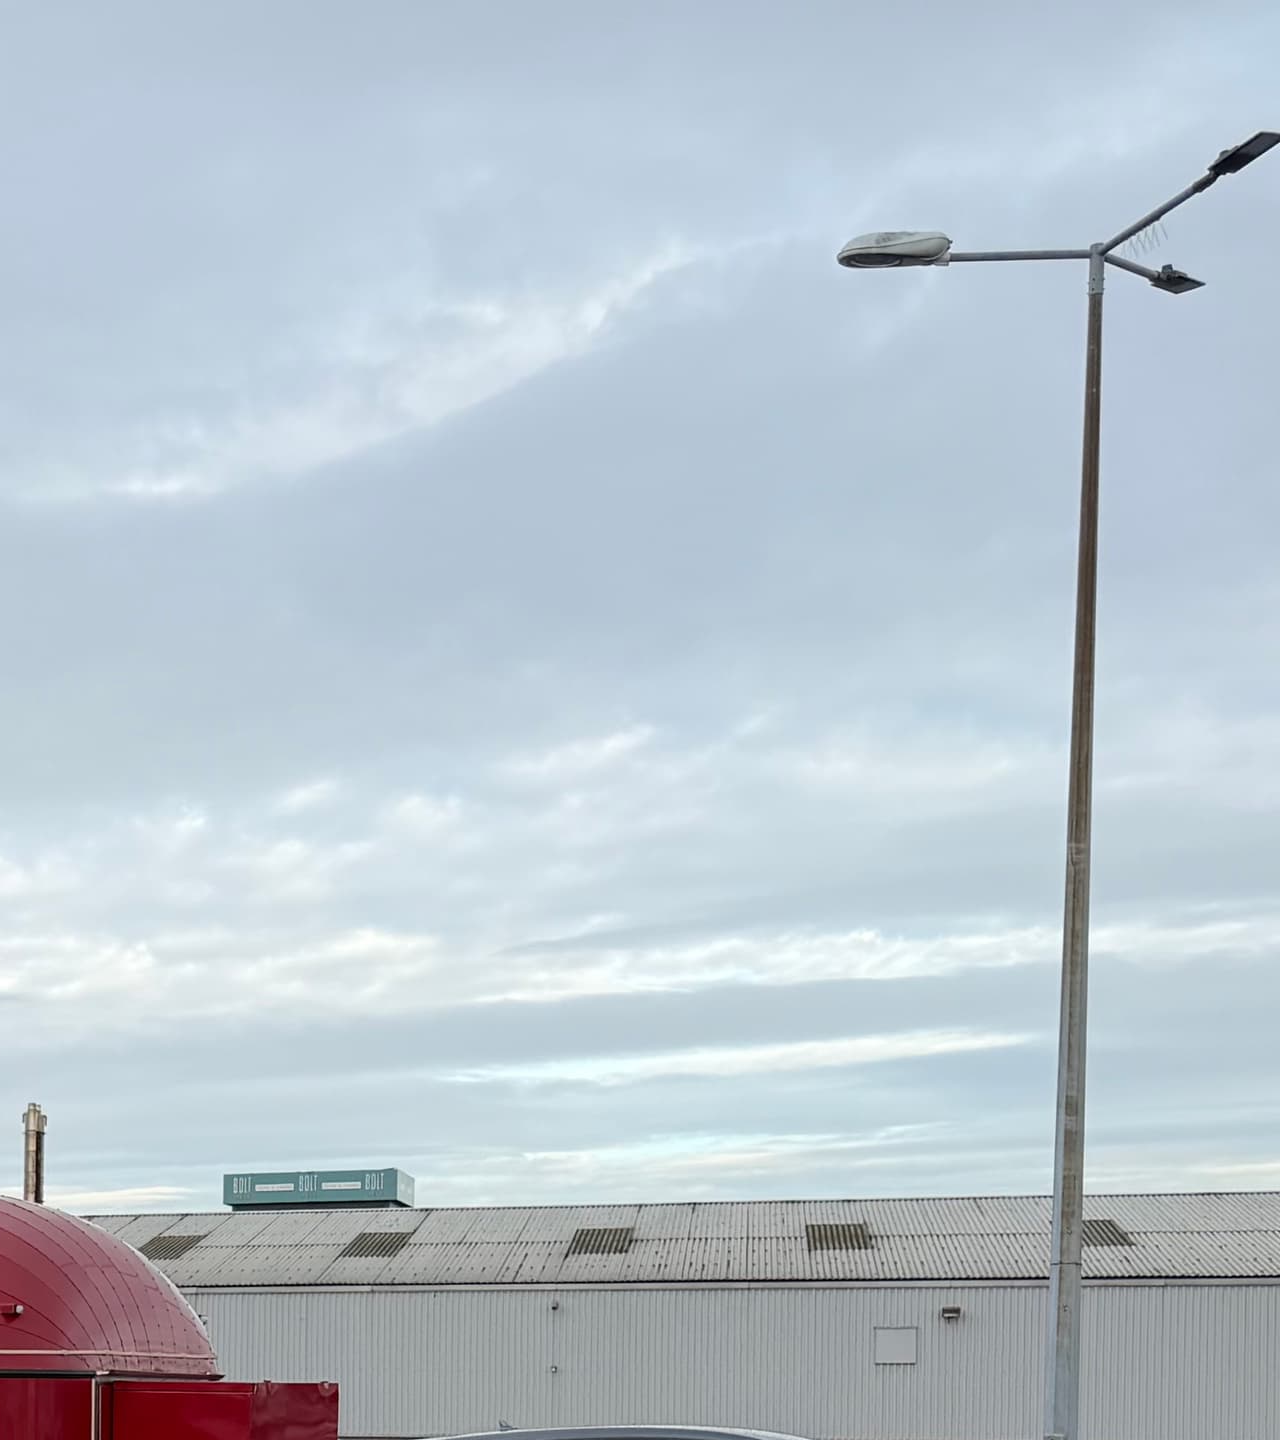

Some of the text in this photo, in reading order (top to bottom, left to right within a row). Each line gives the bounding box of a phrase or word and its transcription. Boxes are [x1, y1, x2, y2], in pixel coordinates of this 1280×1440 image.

[233, 1176, 252, 1194] BOLT
[298, 1174, 318, 1192] BOLT
[365, 1173, 384, 1190] BOLT
